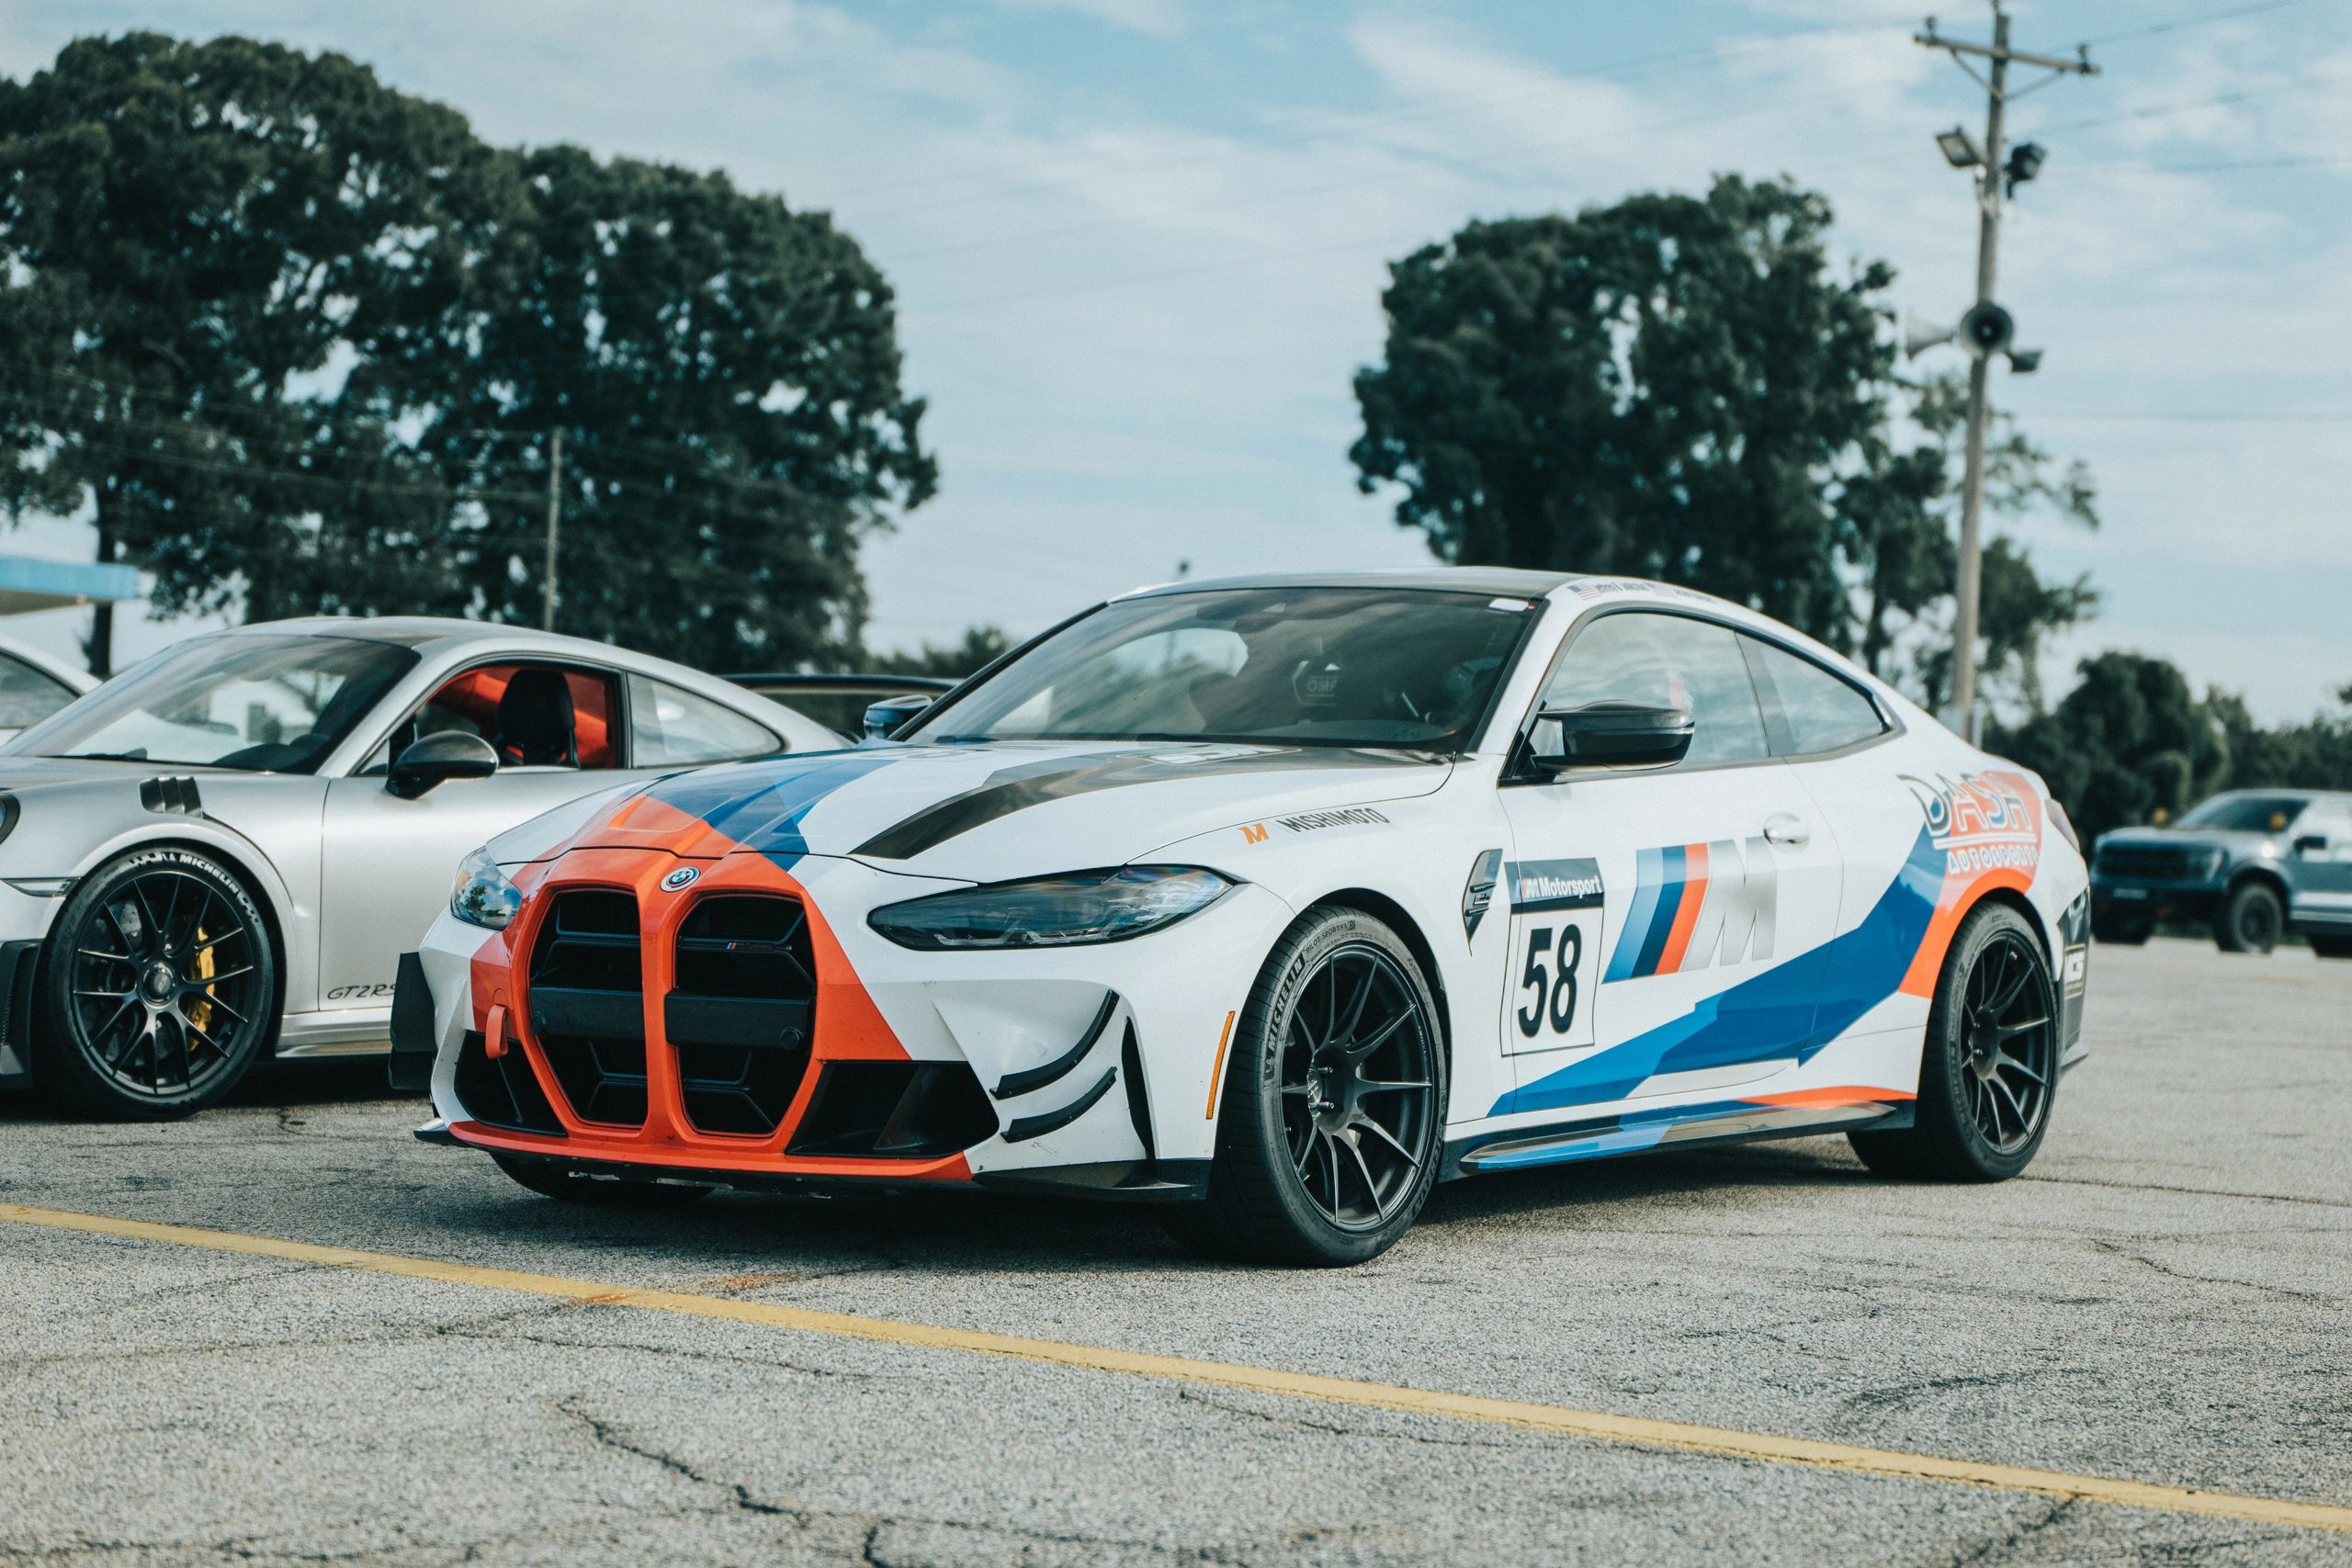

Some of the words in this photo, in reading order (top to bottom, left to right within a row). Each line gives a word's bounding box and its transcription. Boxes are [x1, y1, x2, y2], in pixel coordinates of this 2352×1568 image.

[1238, 822, 1270, 846] M
[1275, 807, 1391, 833] MISHIMOTO
[1896, 773, 2034, 837] DASH
[179, 853, 239, 895] MICHELIN
[1539, 874, 1602, 899] Motorsport
[1267, 958, 1306, 1053] MICHELIN
[1518, 923, 1582, 1038] 58
